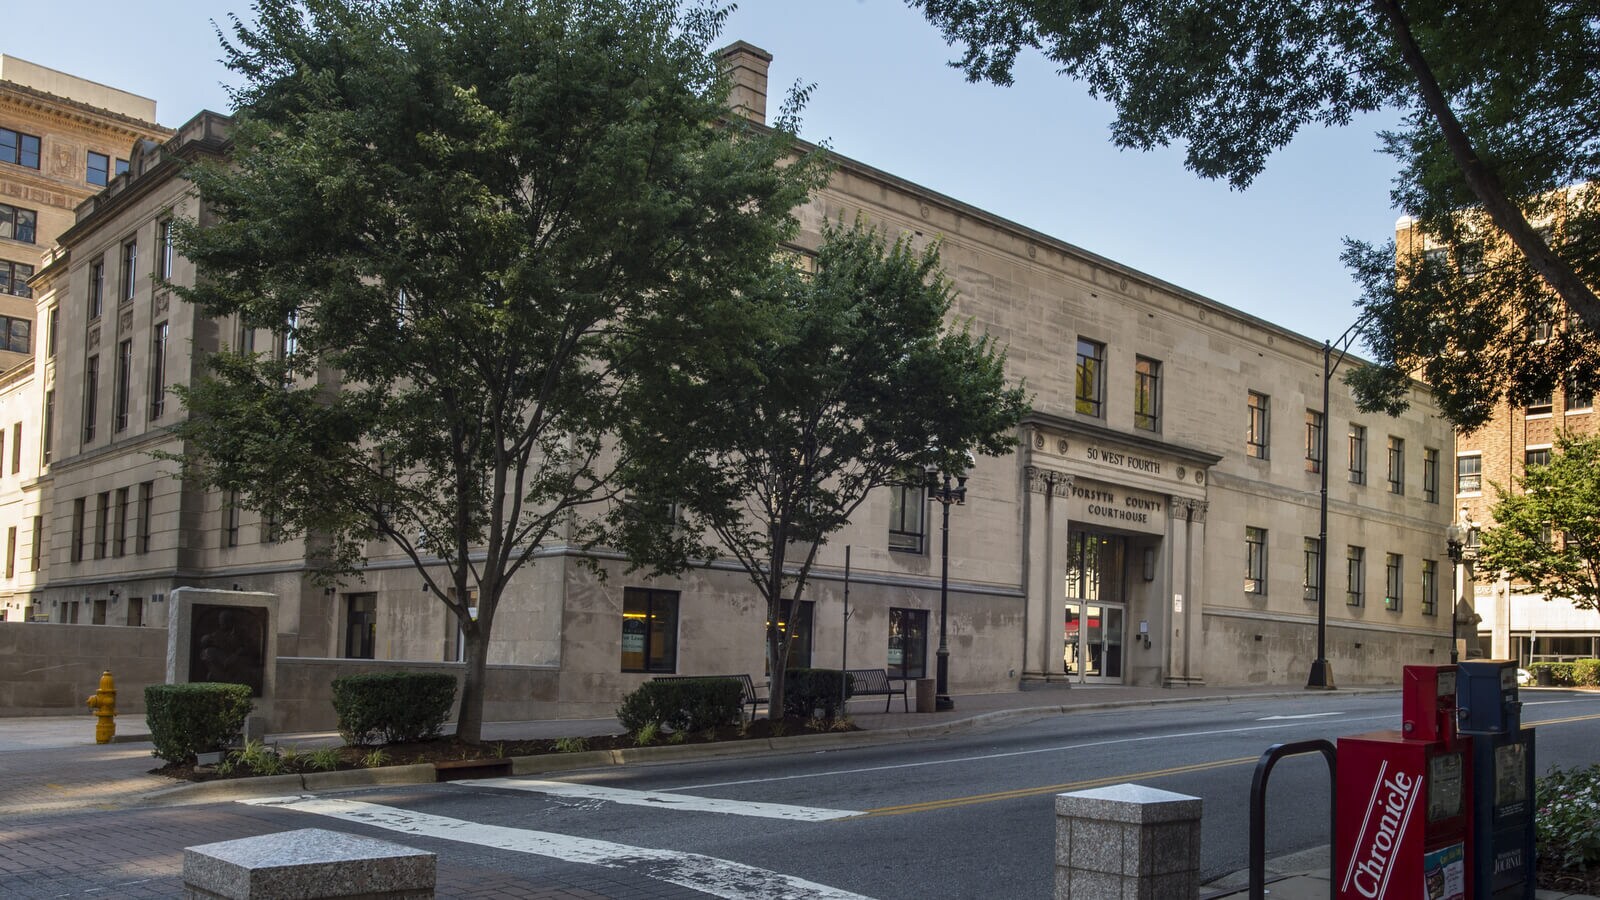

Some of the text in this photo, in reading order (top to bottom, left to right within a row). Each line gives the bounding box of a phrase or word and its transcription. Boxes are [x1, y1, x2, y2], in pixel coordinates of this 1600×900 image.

[1087, 447, 1160, 474] 50 WEST FOURTH
[1072, 487, 1161, 512] FORSYTH COUNTY
[1088, 505, 1147, 524] COURTHOUSE
[1354, 771, 1412, 899] Chronicle
[1494, 855, 1521, 875] JOURNAL
